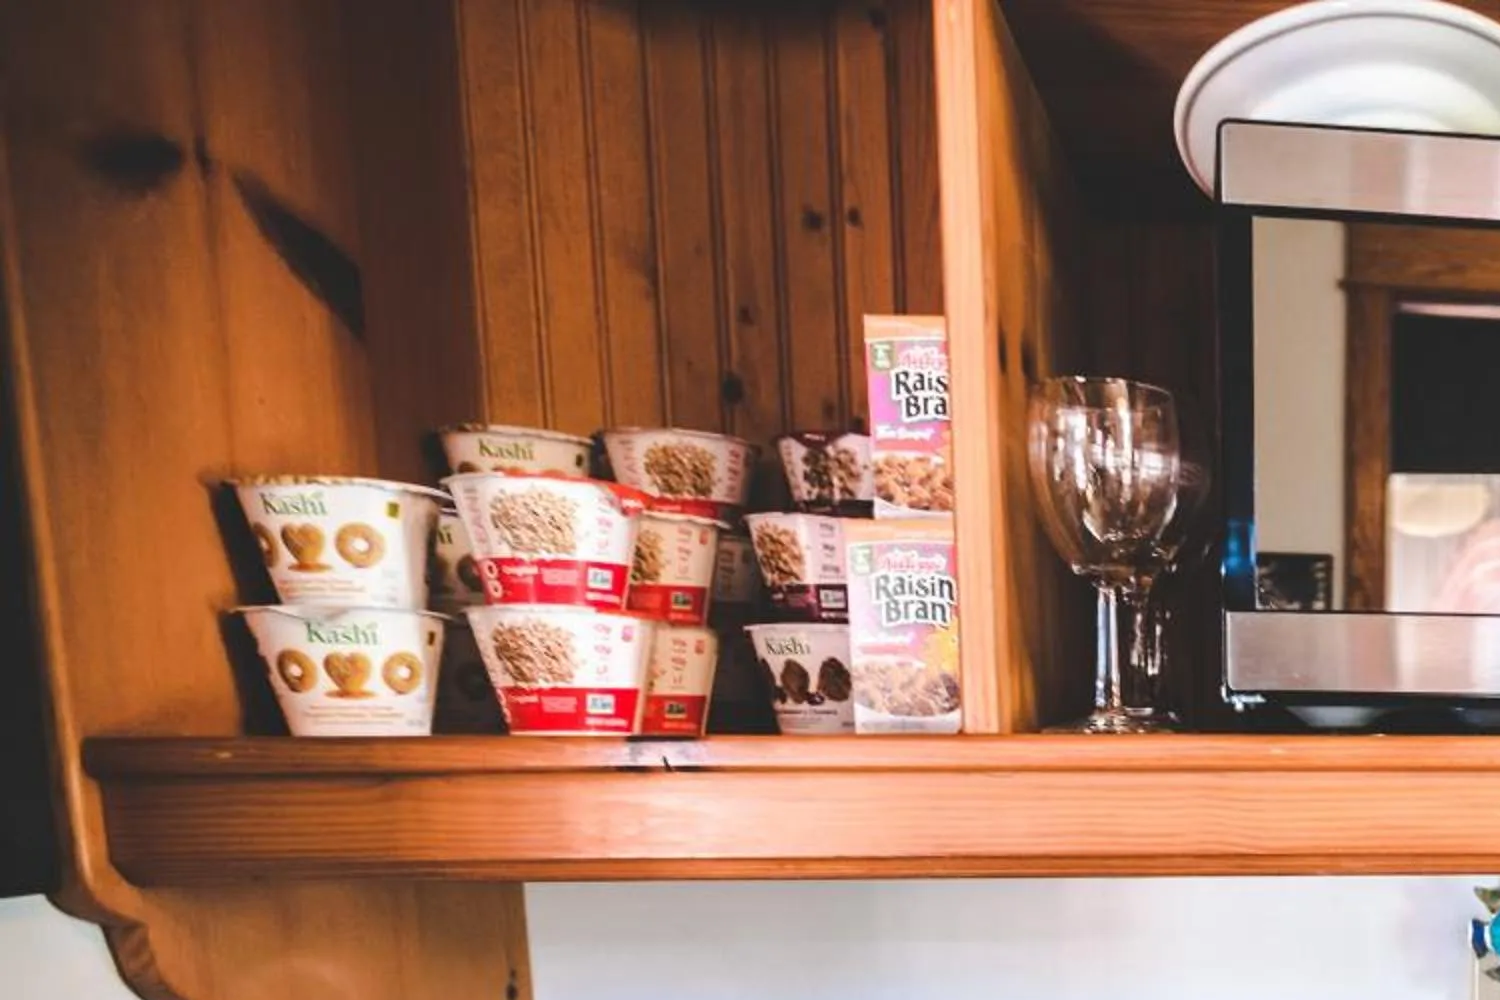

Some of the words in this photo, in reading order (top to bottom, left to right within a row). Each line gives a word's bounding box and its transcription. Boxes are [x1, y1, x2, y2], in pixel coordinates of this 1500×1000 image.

[895, 370, 949, 396] Rais
[905, 394, 947, 418] Bra
[478, 438, 534, 461] Kashi
[260, 490, 328, 516] Kashi
[875, 574, 955, 601] Raisin
[885, 600, 948, 623] Bran
[305, 621, 380, 646] Kashi
[764, 636, 811, 655] Kashi
